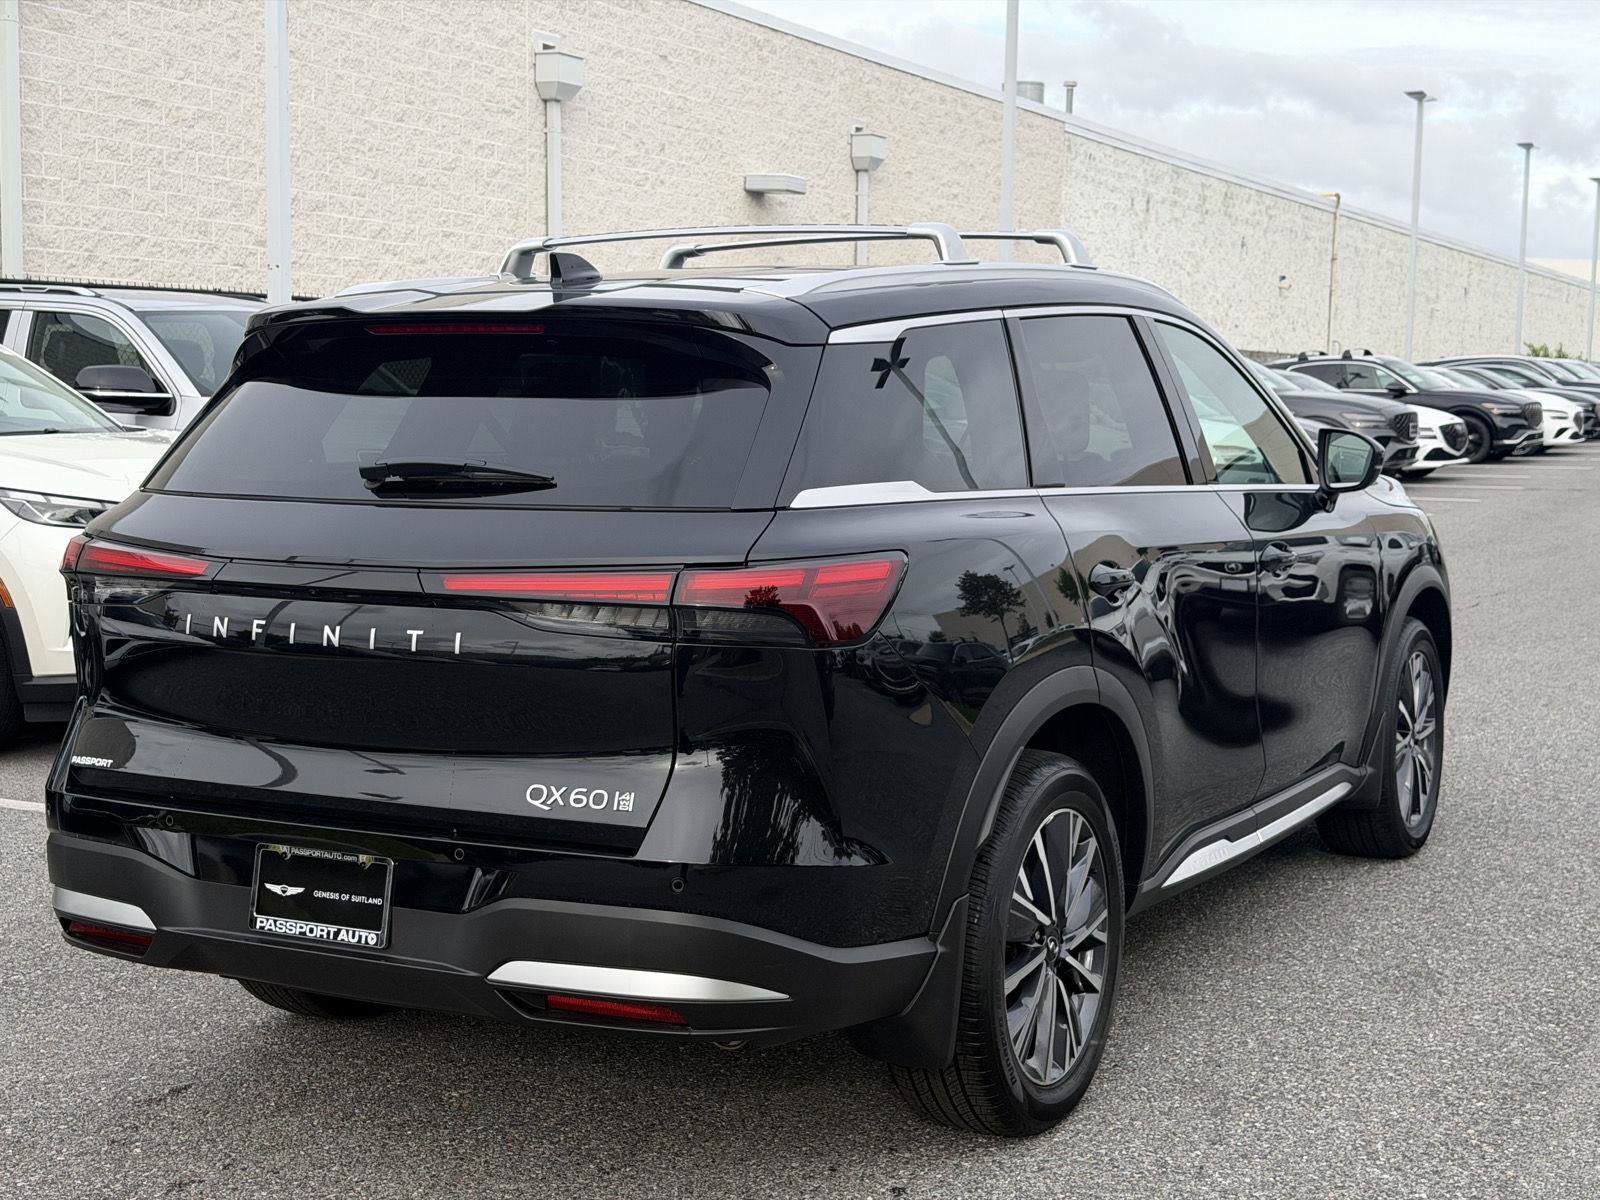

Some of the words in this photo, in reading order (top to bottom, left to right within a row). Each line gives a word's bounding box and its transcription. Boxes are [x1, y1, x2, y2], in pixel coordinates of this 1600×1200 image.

[185, 614, 462, 654] INFINITI
[71, 755, 113, 767] PASSPORT
[526, 784, 608, 810] QX60
[291, 848, 357, 862] PASSPORTAUTO.com
[313, 890, 339, 899] GENESIS
[341, 893, 350, 901] OF
[351, 895, 382, 905] SUITLAND
